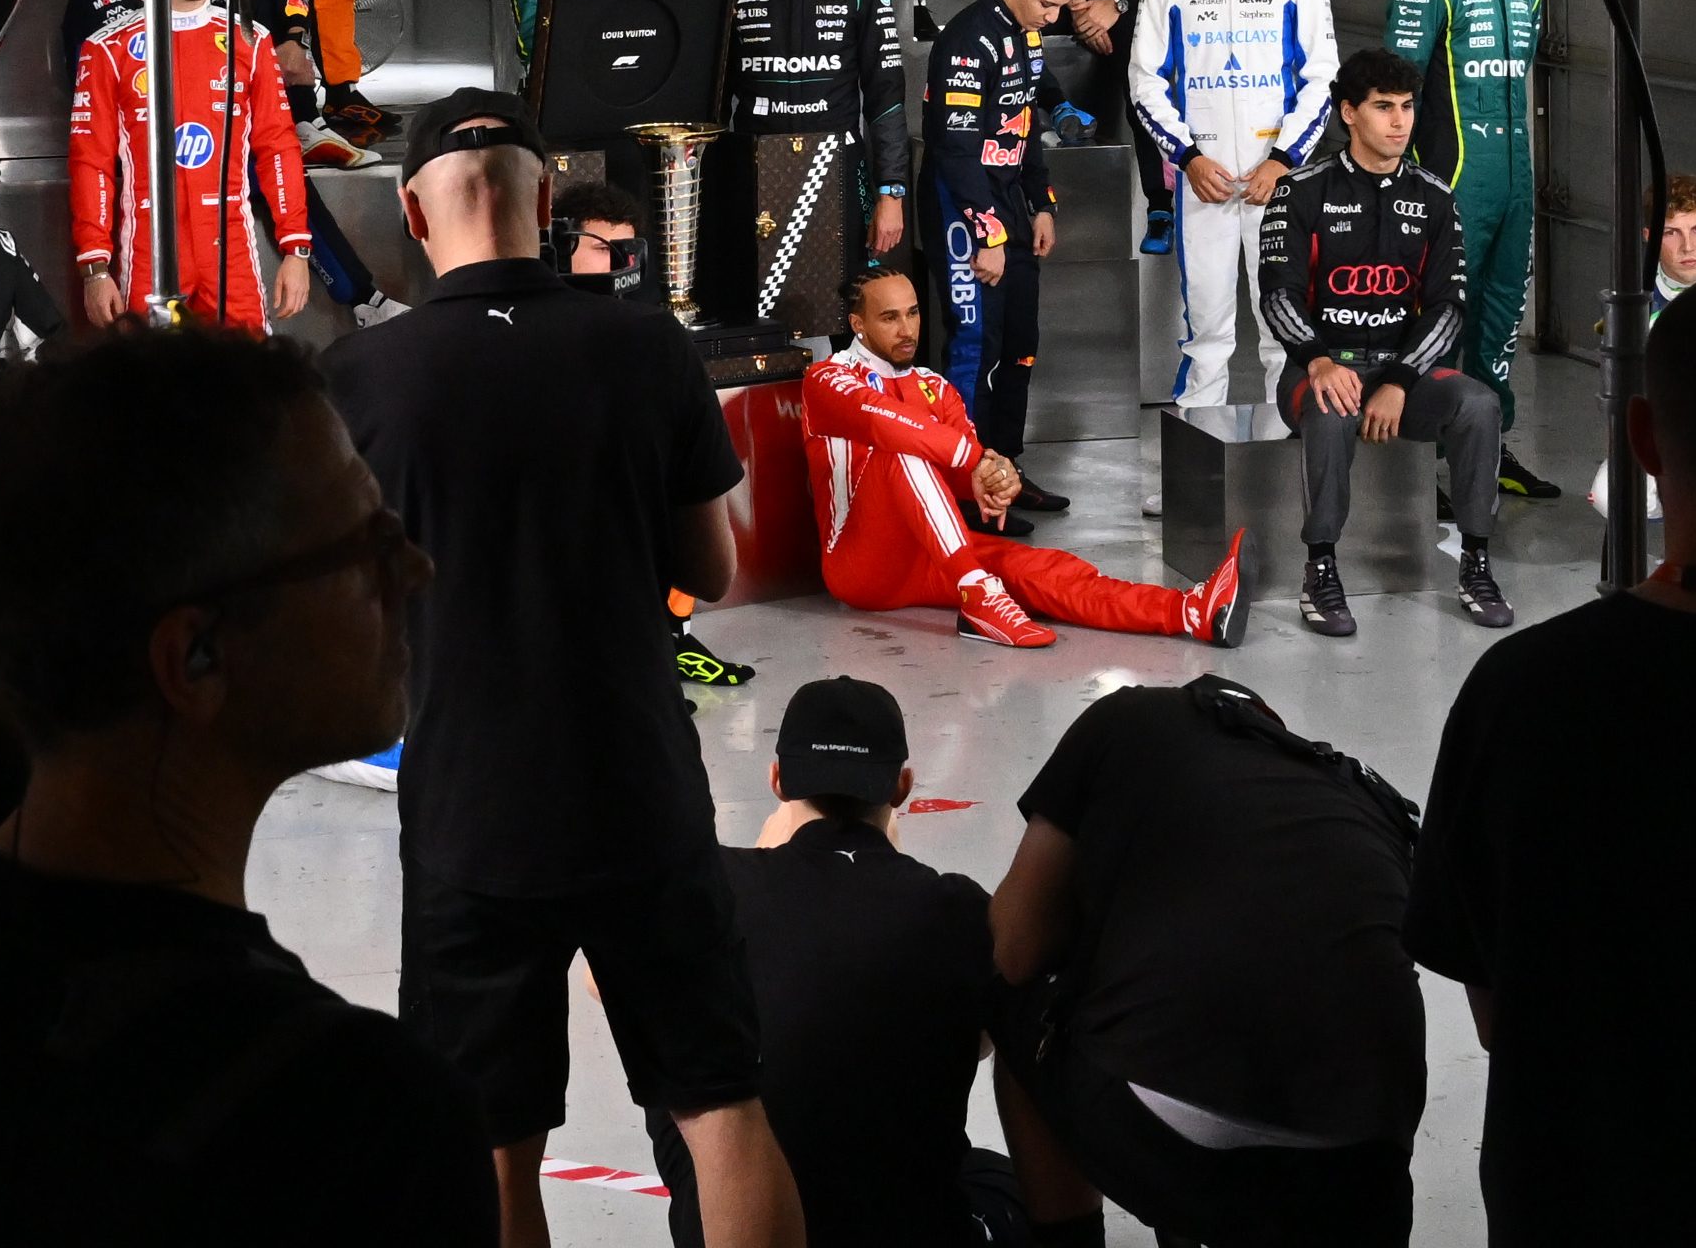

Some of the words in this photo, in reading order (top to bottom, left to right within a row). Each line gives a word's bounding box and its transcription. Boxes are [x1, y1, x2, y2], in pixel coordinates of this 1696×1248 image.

[106, 5, 126, 17] AVA
[748, 8, 768, 18] UBS
[816, 5, 848, 15] INEOS
[1239, 10, 1274, 19] Stephens
[1470, 22, 1493, 33] BOSS
[602, 31, 624, 40] LOUIS
[625, 29, 656, 39] VUITTON
[818, 32, 844, 41] HPE
[1205, 29, 1278, 45] BARCLAYS
[1470, 37, 1494, 48] JCB
[741, 55, 842, 73] PETRONAS
[951, 56, 980, 69] Mobil
[955, 71, 975, 81] AVA
[1188, 74, 1281, 90] ATLASSIAN
[946, 78, 982, 90] TRADE
[771, 98, 828, 114] Microsoft
[176, 123, 209, 168] hp
[981, 139, 1023, 166] Red
[1264, 205, 1287, 214] evolut
[1323, 203, 1362, 214] Revolut
[1411, 225, 1421, 235] bp
[947, 221, 976, 325] ORBR
[614, 272, 641, 291] RONIN
[1322, 308, 1407, 327] Revolut
